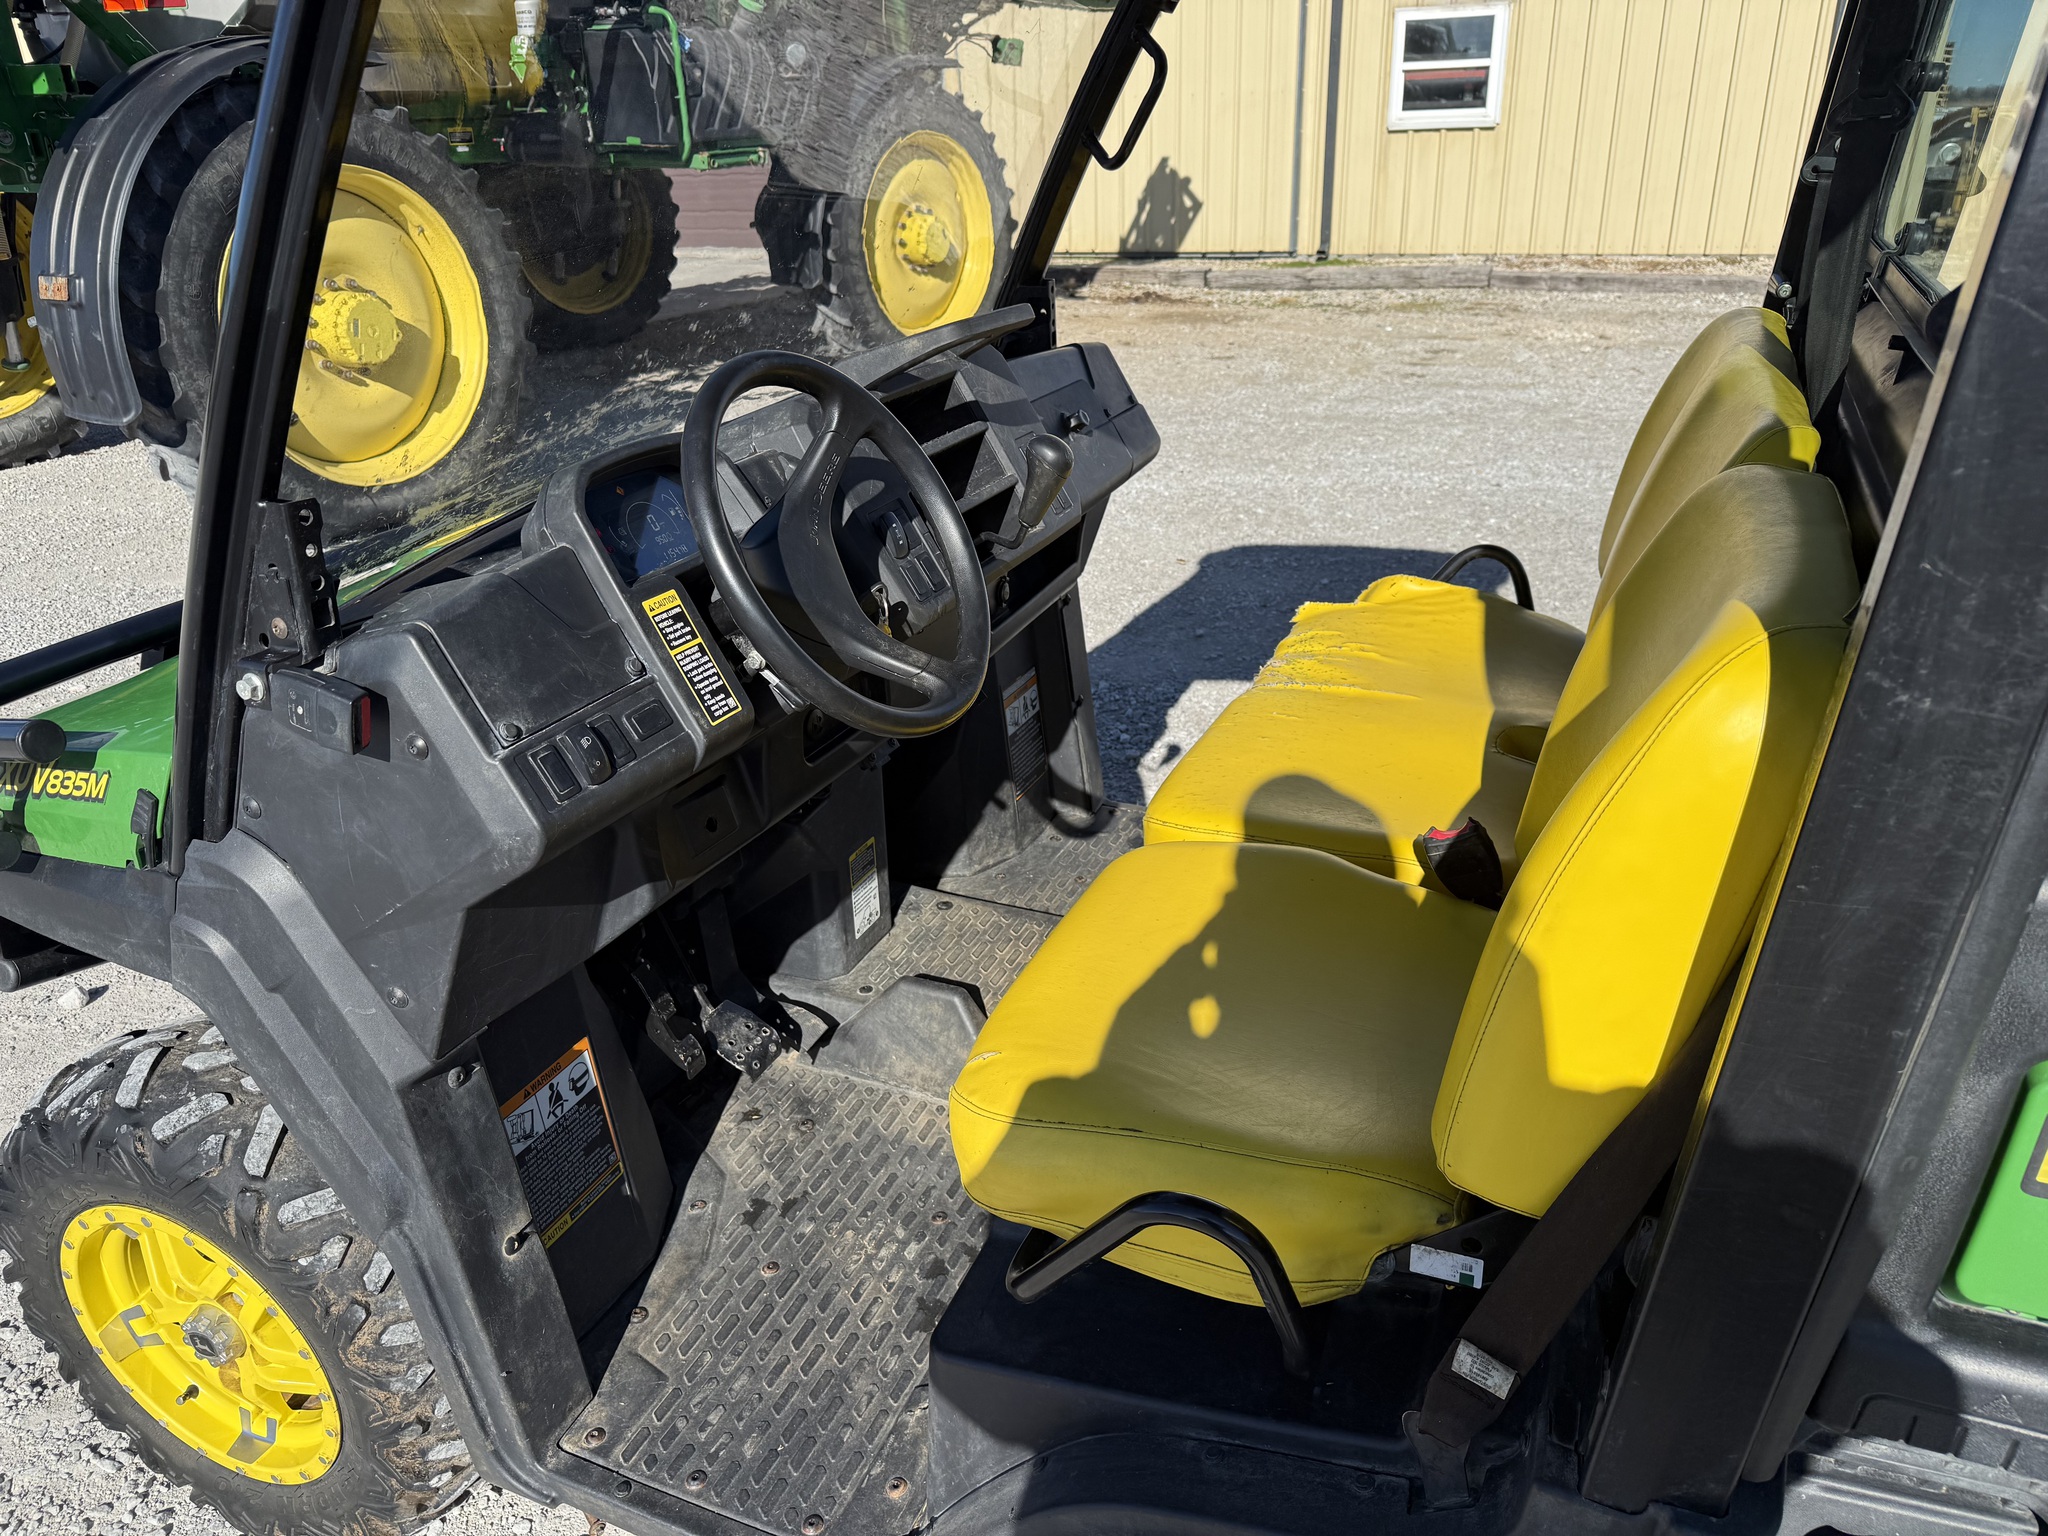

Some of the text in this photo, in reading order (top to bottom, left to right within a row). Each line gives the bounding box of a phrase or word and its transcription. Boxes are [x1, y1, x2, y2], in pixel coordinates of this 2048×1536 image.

[652, 594, 677, 609] CAUTION
[530, 1061, 561, 1092] WARNING
[525, 1103, 587, 1161] from Rollover or Falling Off
[530, 1104, 578, 1149] Avoid Injury or Death
[543, 1217, 568, 1245] CAUTION
